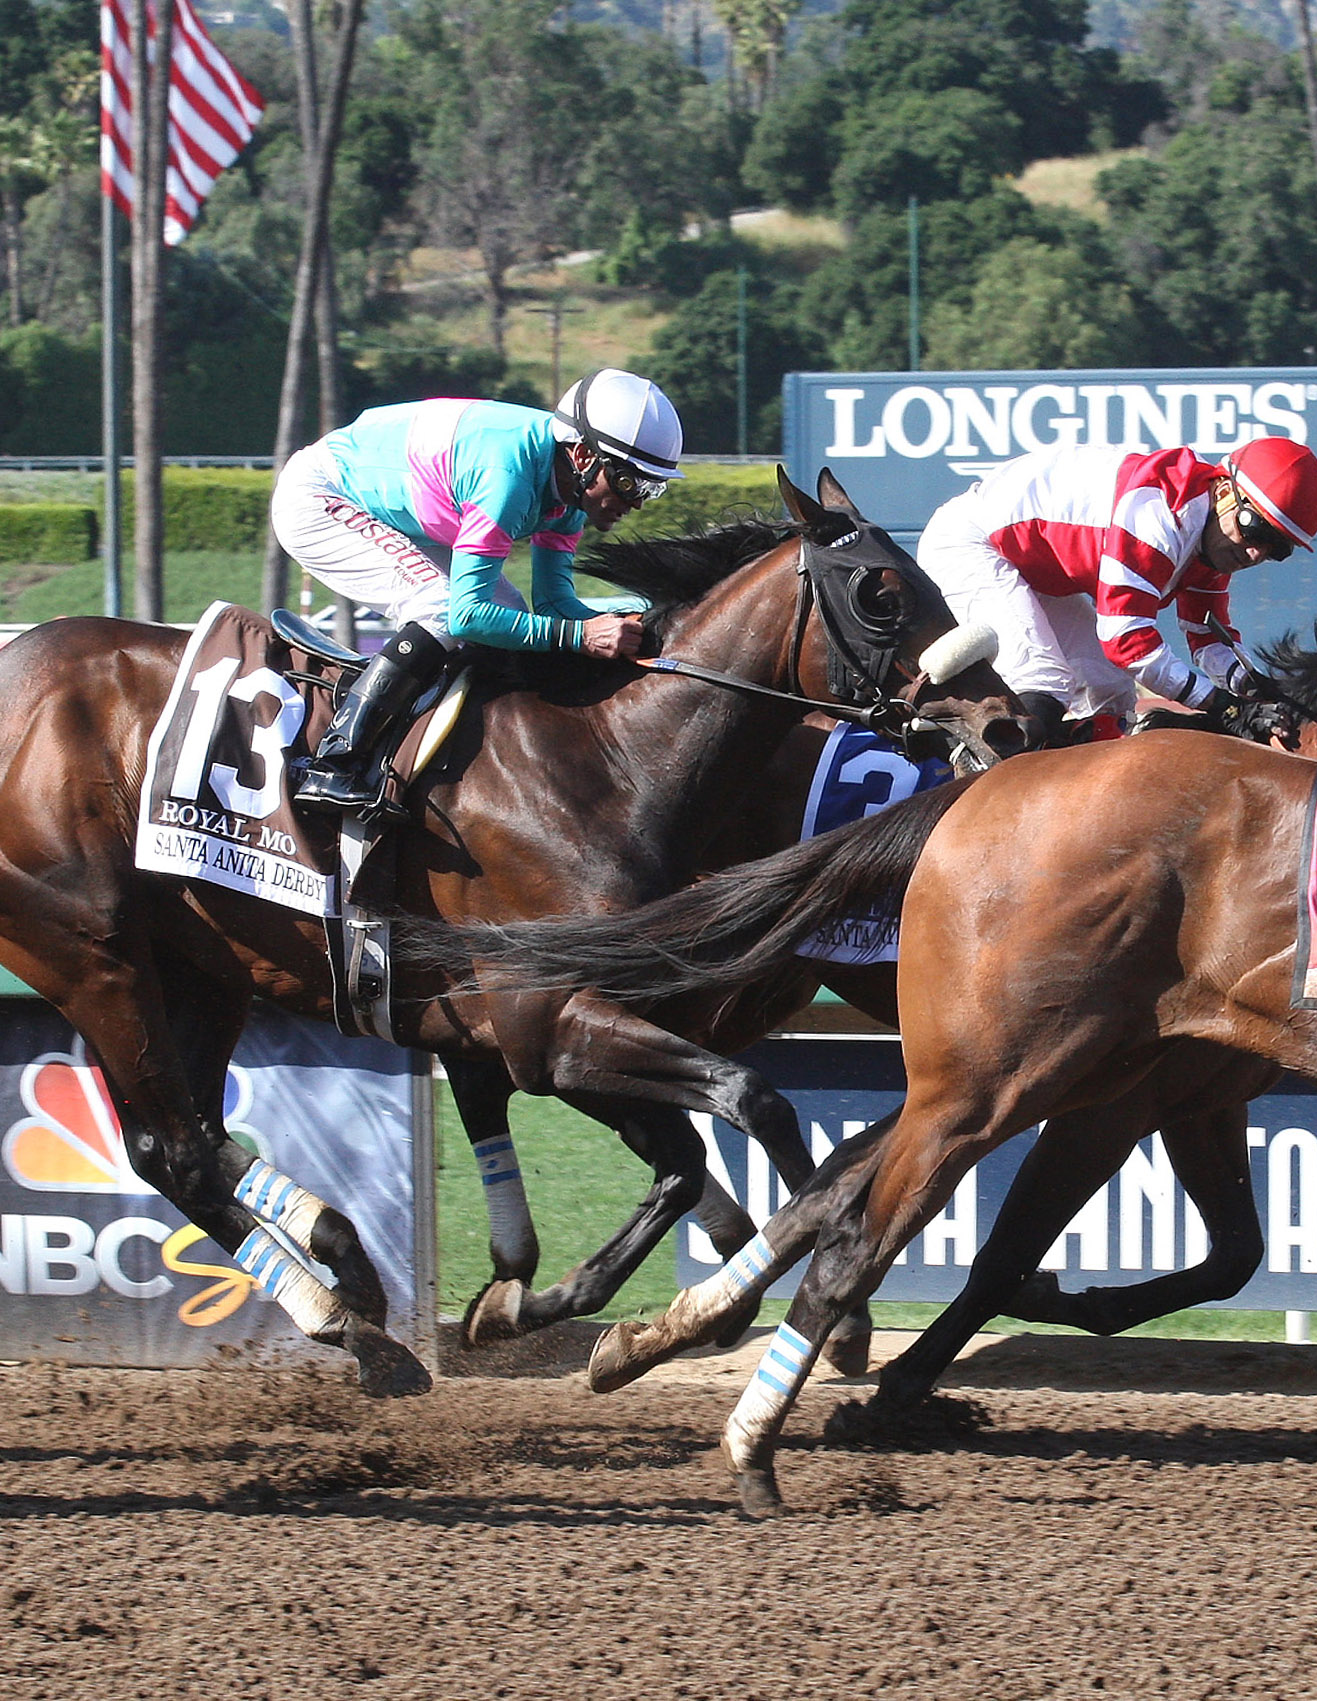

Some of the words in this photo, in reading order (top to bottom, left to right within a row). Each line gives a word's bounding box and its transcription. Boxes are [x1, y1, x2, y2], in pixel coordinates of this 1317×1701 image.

[825, 381, 1308, 460] LONGINES
[170, 656, 306, 819] 13
[839, 749, 921, 818] 3
[159, 800, 251, 842] ROYAL
[257, 825, 297, 856] MO
[154, 831, 208, 864] SANTA
[213, 845, 266, 882] ANITA
[271, 862, 326, 901] DERBY
